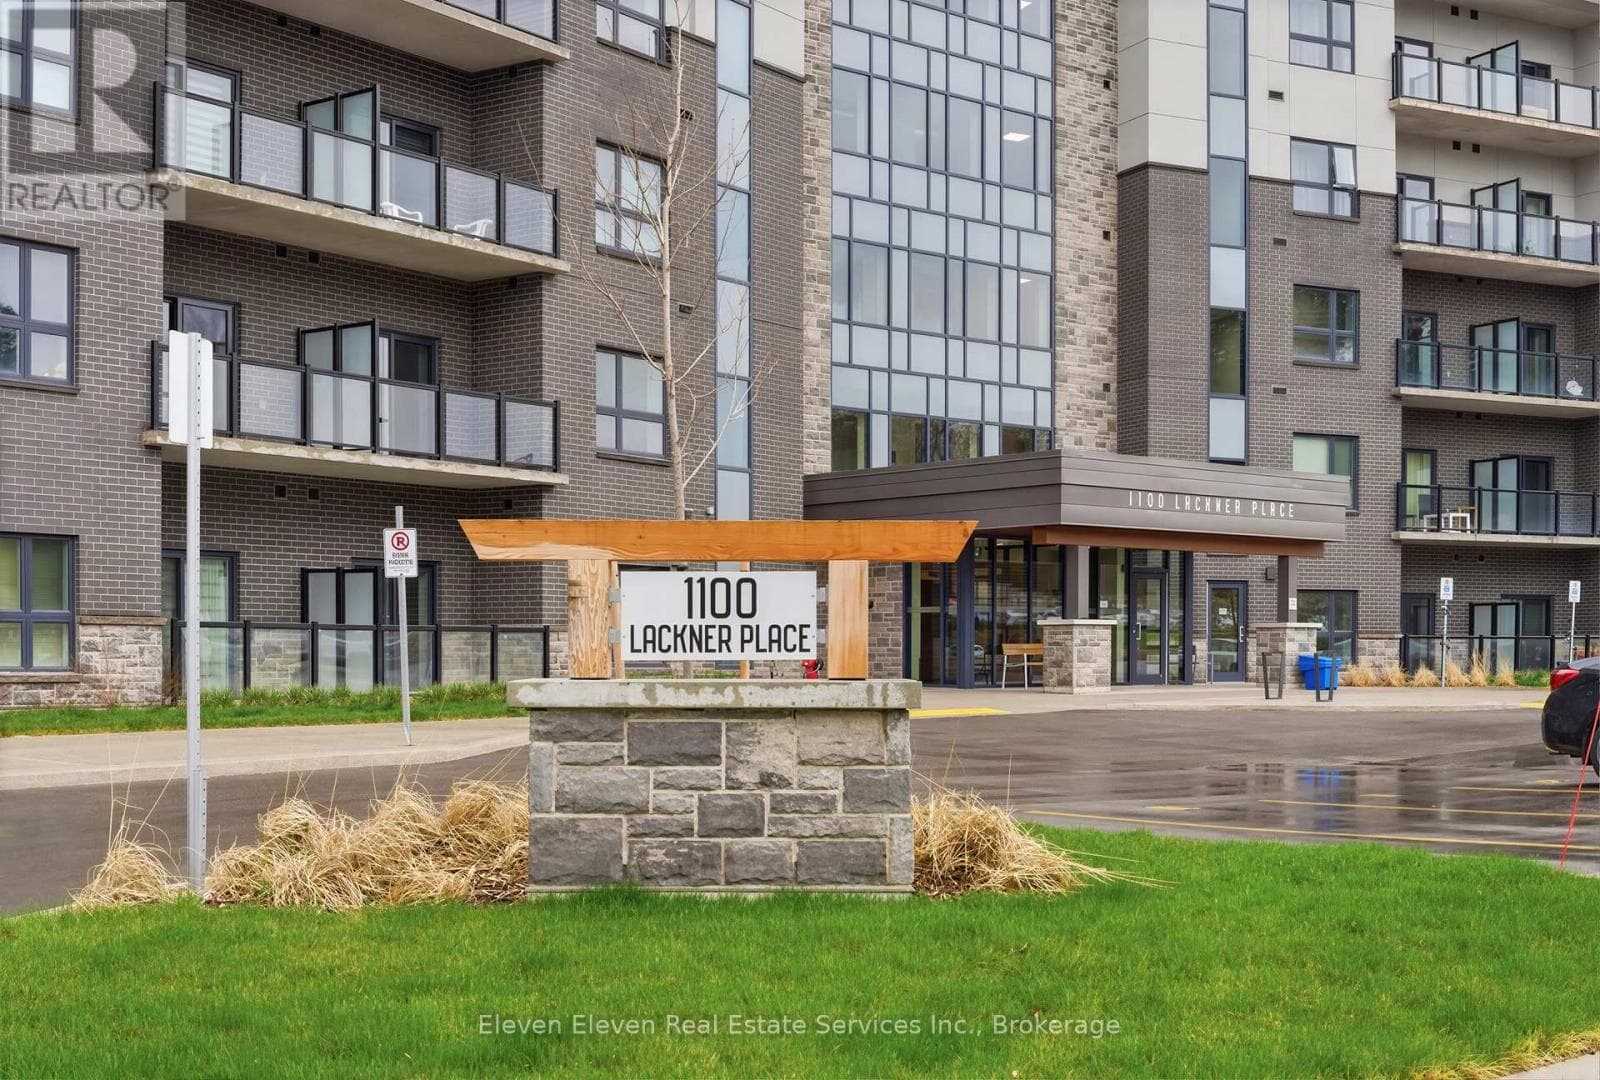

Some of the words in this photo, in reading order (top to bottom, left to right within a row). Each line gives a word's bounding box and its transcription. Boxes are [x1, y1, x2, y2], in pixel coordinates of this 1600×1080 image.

[1128, 490, 1165, 509] 1100
[1174, 494, 1241, 514] LACKNER
[1251, 501, 1295, 518] PLACE
[684, 577, 757, 619] 1100
[629, 624, 732, 654] LACKNER
[740, 624, 811, 653] PLACE
